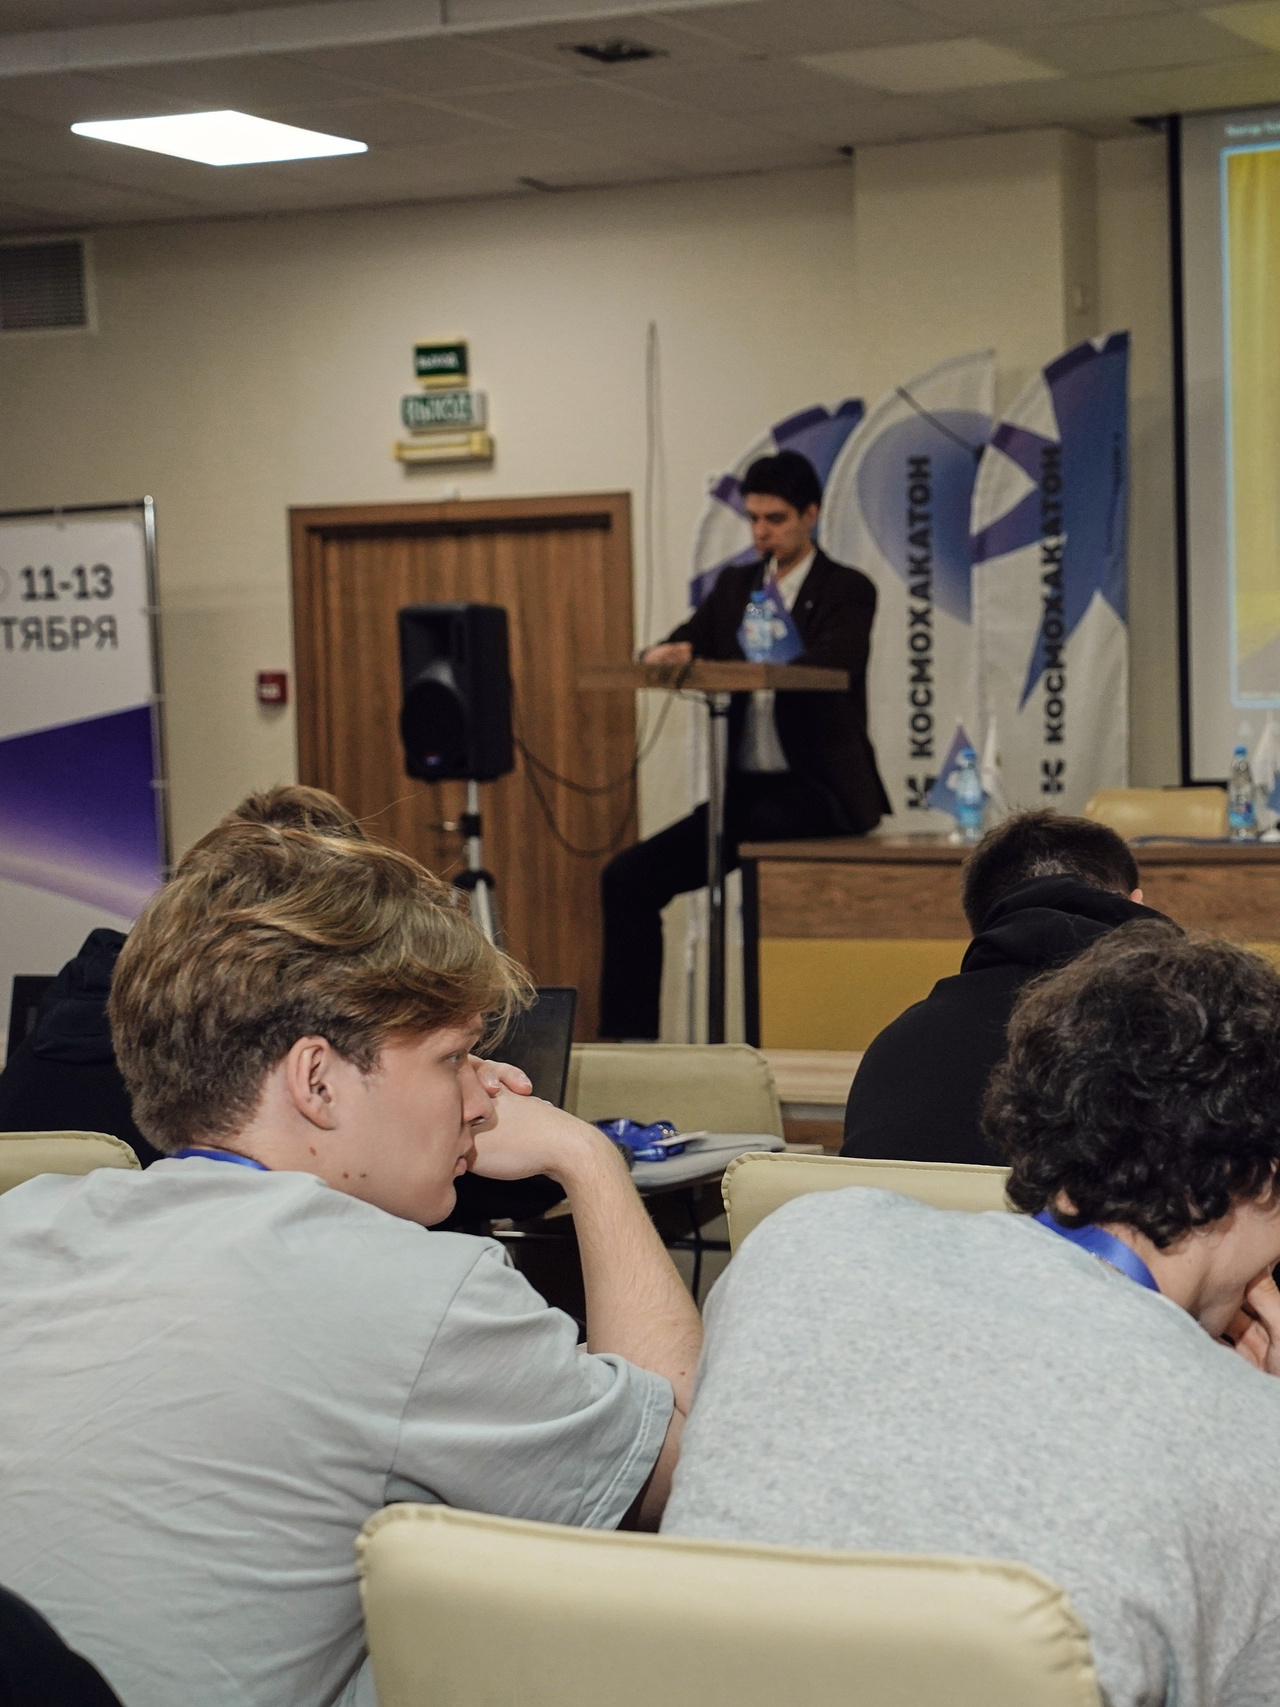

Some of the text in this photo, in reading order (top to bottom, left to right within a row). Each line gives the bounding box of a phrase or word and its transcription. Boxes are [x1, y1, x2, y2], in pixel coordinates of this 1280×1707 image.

[22, 563, 114, 601] 11-13
[907, 455, 933, 759] КОСМОХАКАТОН
[1040, 445, 1065, 744] КОСМОХАКАТОН
